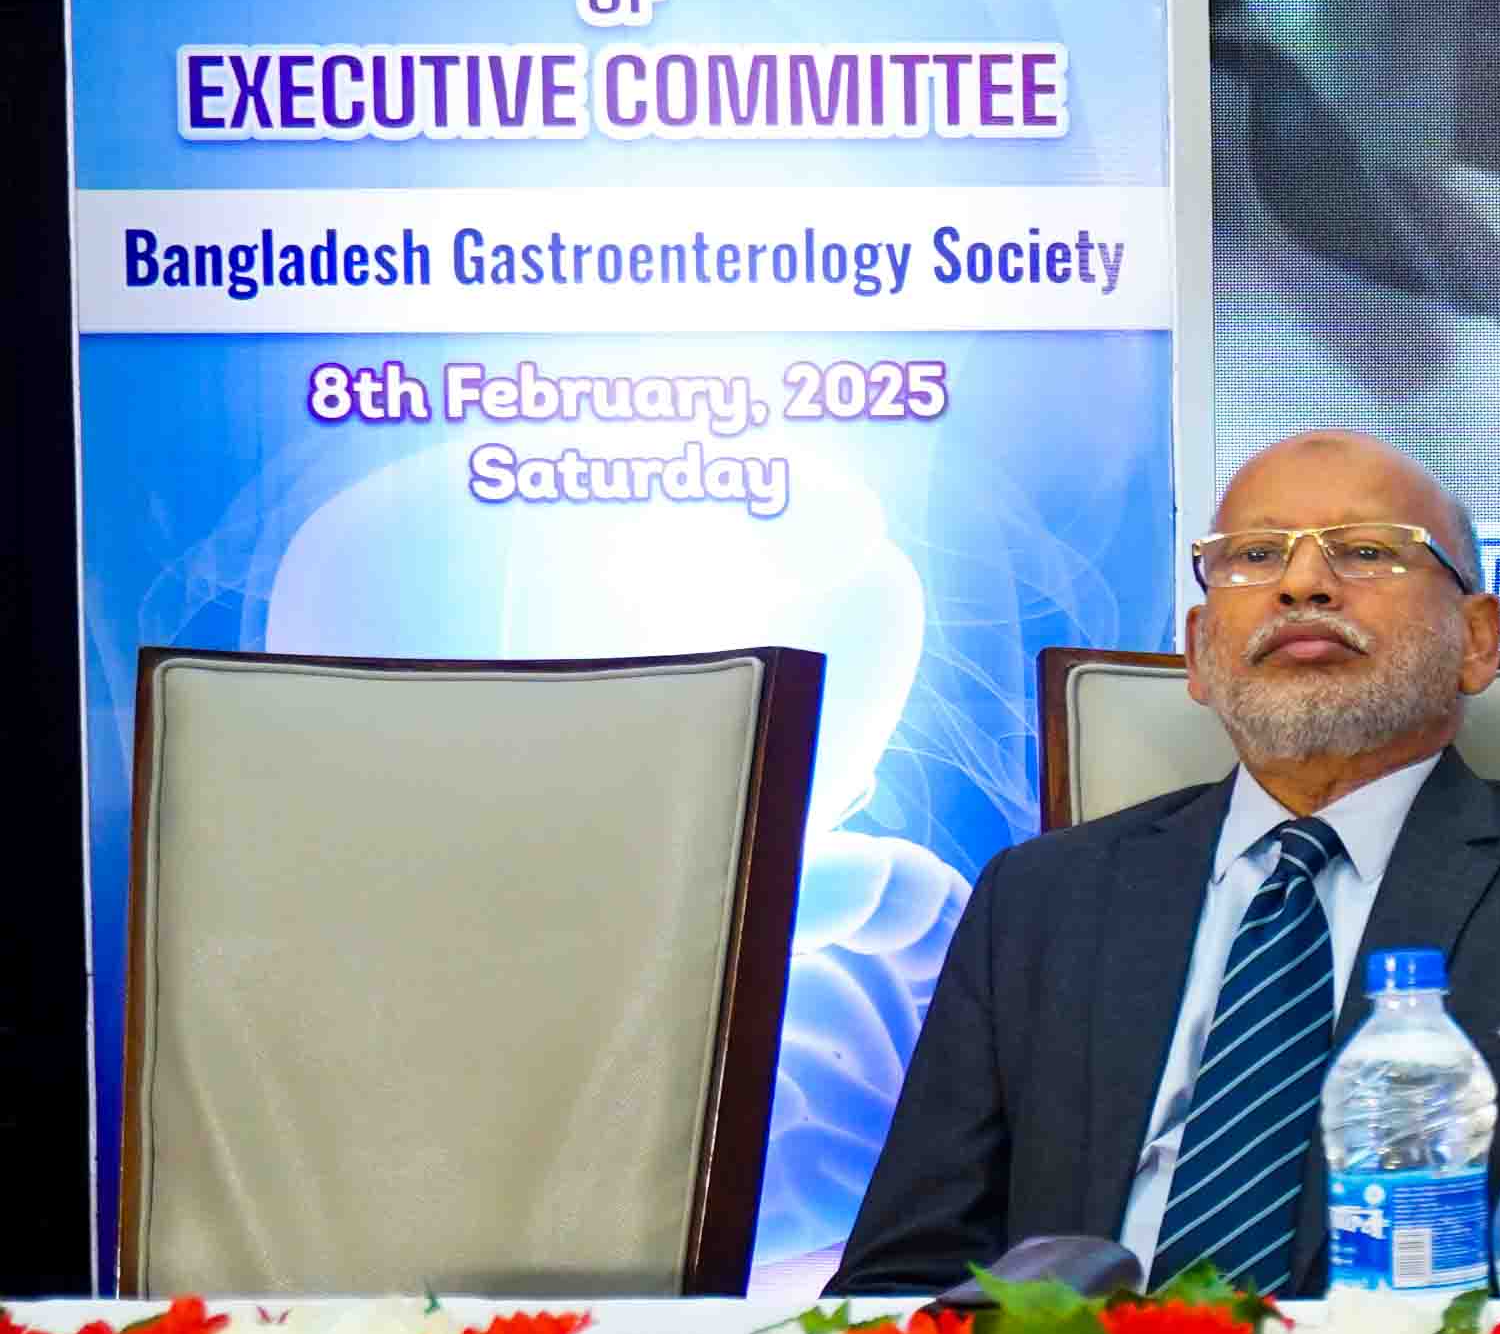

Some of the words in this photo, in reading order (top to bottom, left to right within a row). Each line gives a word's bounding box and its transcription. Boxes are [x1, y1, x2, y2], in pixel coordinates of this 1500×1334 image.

[186, 51, 578, 129] EXECUTIVE
[604, 51, 1060, 127] COMMITTEE
[125, 228, 431, 302] Bangladesh
[453, 227, 914, 298] Gastroenterology
[933, 224, 1126, 296] Society
[308, 361, 431, 423] 8th
[444, 361, 771, 435] February,
[784, 360, 948, 420] 2025
[469, 443, 790, 517] Saturday
